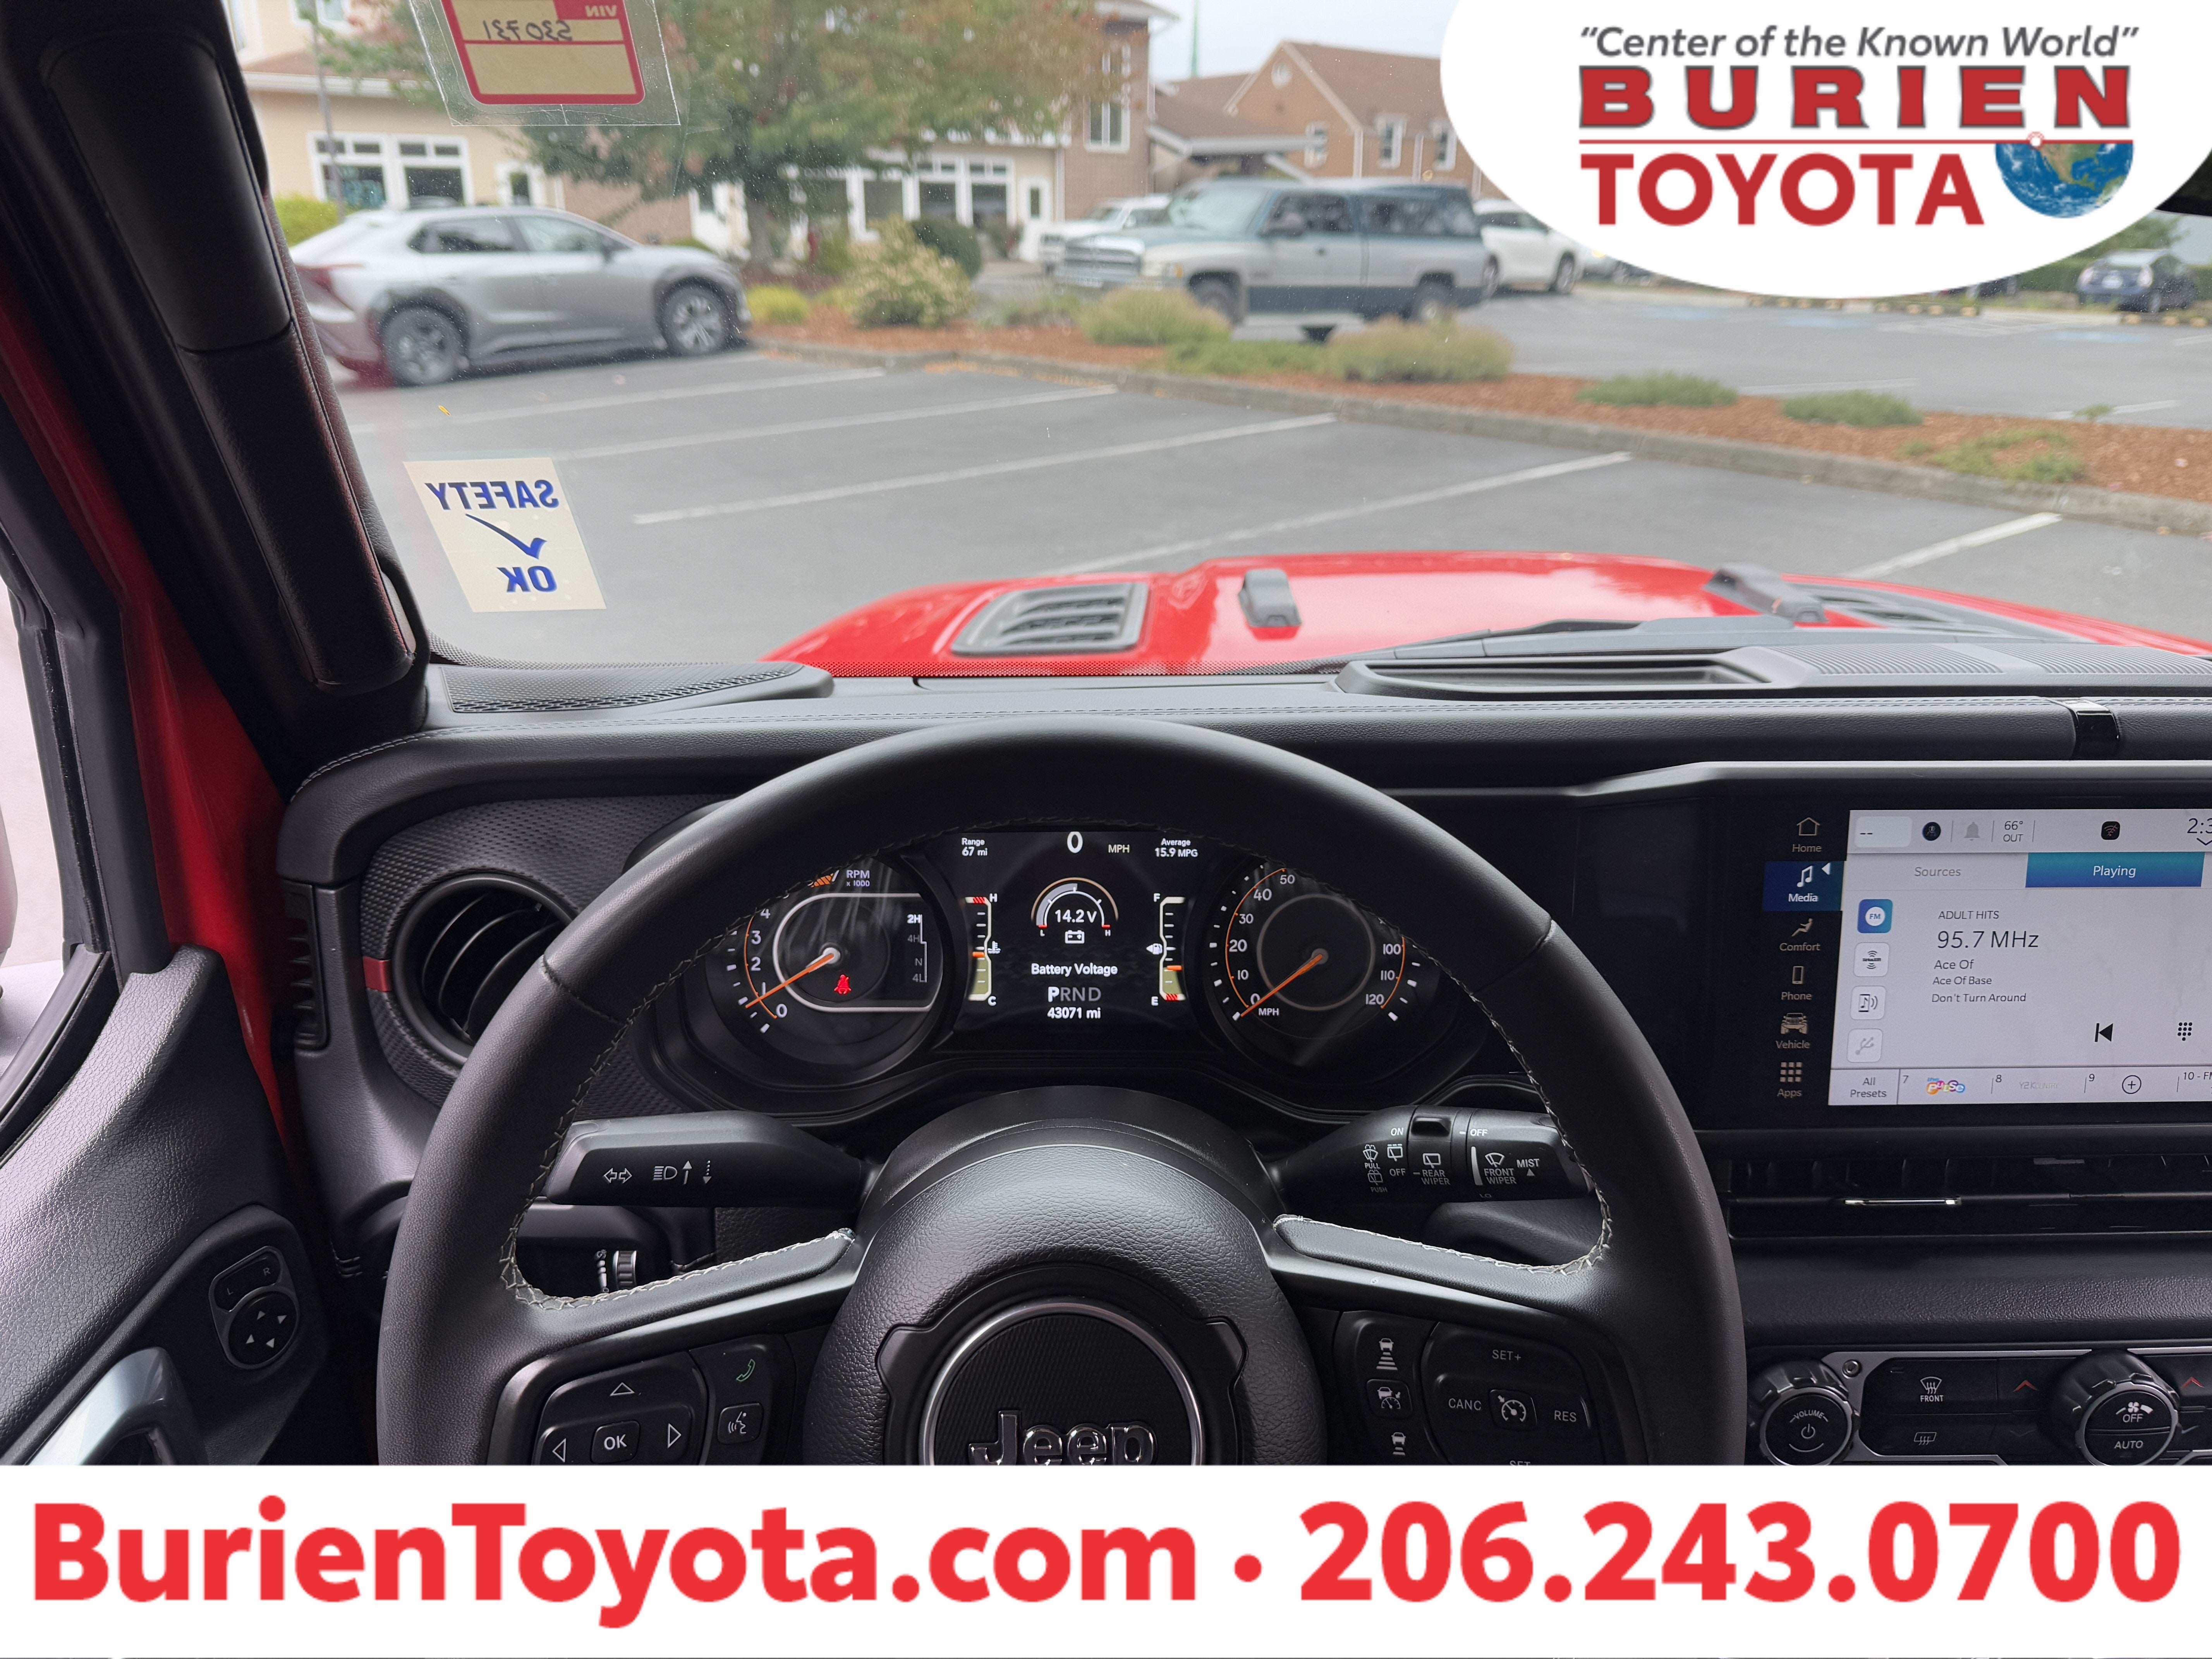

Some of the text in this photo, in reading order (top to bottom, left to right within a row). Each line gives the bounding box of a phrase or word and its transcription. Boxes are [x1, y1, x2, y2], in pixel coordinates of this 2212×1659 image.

[2004, 821, 2023, 830] 66°
[961, 838, 985, 846] Range
[1067, 831, 1083, 853] 0
[1161, 838, 1191, 847] Average
[2003, 834, 2023, 842] OUT
[962, 847, 988, 856] 67 mi
[1108, 845, 1130, 854] MPH
[1155, 848, 1198, 857] 15.9 MPG
[1792, 844, 1822, 852] Home
[846, 869, 870, 879] RPM
[1914, 867, 1961, 877] Sources
[2093, 866, 2136, 878] Playing
[1280, 875, 1295, 884] 50
[989, 893, 998, 902] H
[1153, 893, 1161, 902] F
[1254, 889, 1272, 901] 40
[1788, 893, 1819, 902] Media
[760, 908, 771, 919] 4
[1054, 910, 1097, 923] 14.2 V
[1938, 910, 1999, 920] ADULT HITS
[907, 914, 922, 924] 2H
[1239, 914, 1254, 925] 30
[751, 931, 762, 945] 3
[907, 934, 920, 943] 4H
[1937, 931, 2040, 949] 95.7 MHz
[1229, 939, 1248, 952] 20
[1382, 943, 1401, 955] 100
[1779, 942, 1821, 951] Comfort
[750, 957, 761, 972] 2
[915, 958, 923, 967] N
[1934, 959, 1975, 970] Ace Of
[1031, 963, 1118, 977] Battery Voltage
[1237, 969, 1249, 980] 10
[1381, 970, 1395, 981] 110
[1932, 976, 1992, 985] Ace Of Base
[988, 996, 997, 1006] C
[1151, 996, 1159, 1006] E
[1250, 993, 1260, 1005] 0
[1365, 994, 1385, 1005] 120
[1781, 992, 1812, 1001] Phone
[1932, 993, 2027, 1003] Don't Turn Around
[776, 1004, 788, 1018] 0
[1047, 1007, 1101, 1019] 43071 mi
[1258, 1008, 1279, 1016] MPH
[1775, 1040, 1811, 1049] Vehicle
[1902, 1075, 1909, 1084] 7
[1995, 1074, 2002, 1083] 8
[2088, 1073, 2095, 1082] 9
[2183, 1072, 2195, 1080] 10
[1862, 1077, 1876, 1085] All
[1777, 1089, 1803, 1099] Apps
[1850, 1089, 1887, 1098] Presets
[1390, 1127, 1404, 1136] ON
[1470, 1128, 1488, 1137] OFF
[1516, 1158, 1540, 1168] MIST
[1389, 1168, 1407, 1177] OFF
[1422, 1170, 1446, 1178] REAR
[1484, 1168, 1514, 1176] FRONT
[1421, 1177, 1451, 1185] WIPER
[1486, 1176, 1517, 1185] WIPER
[263, 1267, 271, 1276] R
[1920, 1395, 1944, 1403] FRONT
[1448, 1398, 1482, 1411] CANC
[1554, 1410, 1577, 1423] RES
[1794, 1409, 1825, 1419] VOLUME
[2123, 1414, 2143, 1422] OFF
[968, 1410, 1157, 1465] Jeep
[603, 1434, 628, 1451] OK
[2114, 1440, 2143, 1449] AUTO
